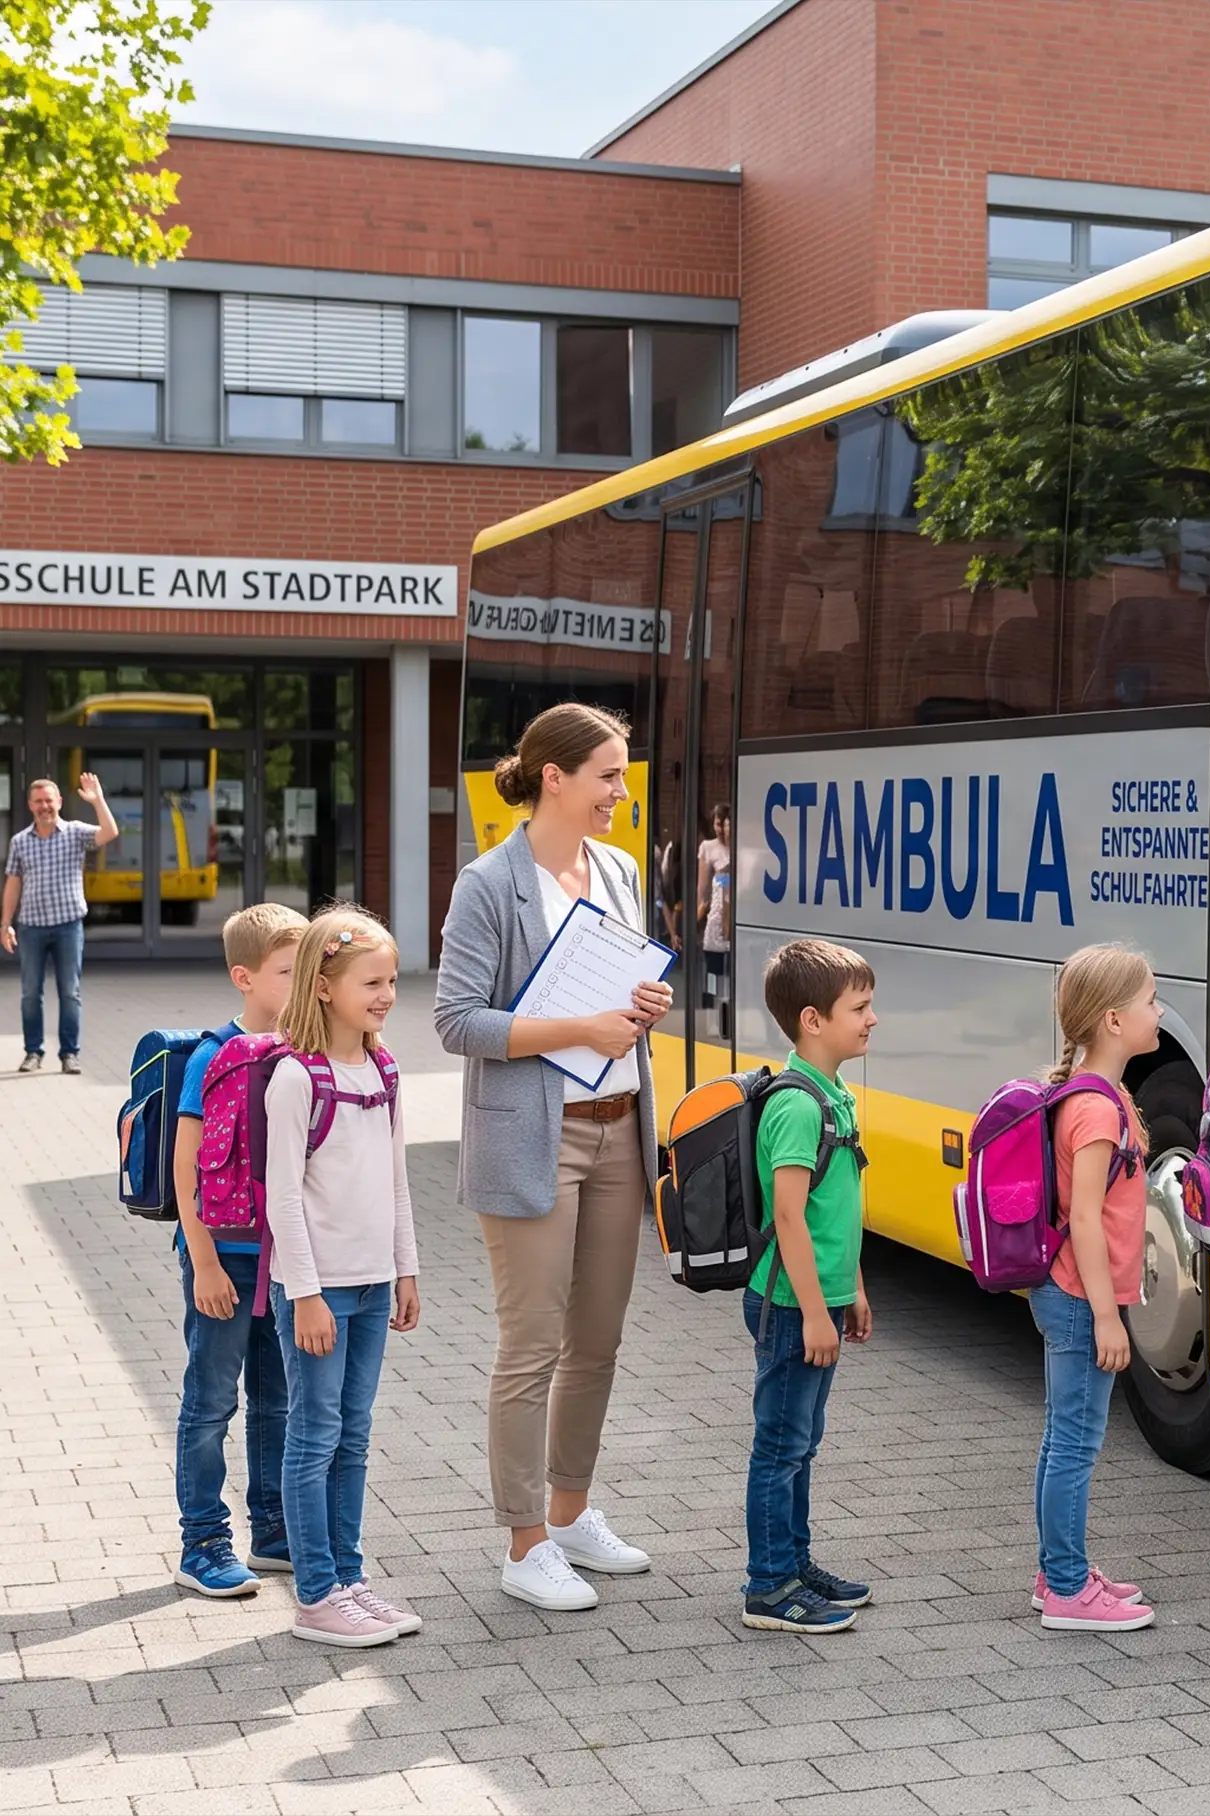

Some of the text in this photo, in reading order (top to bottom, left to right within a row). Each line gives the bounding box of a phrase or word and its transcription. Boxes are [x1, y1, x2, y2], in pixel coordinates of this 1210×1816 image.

[169, 568, 227, 599] AM
[242, 570, 445, 605] STADTPARK
[1111, 779, 1199, 813] SICHERE &
[763, 772, 1075, 926] STAMBULA
[1101, 826, 1210, 860] ENTSPANNTE
